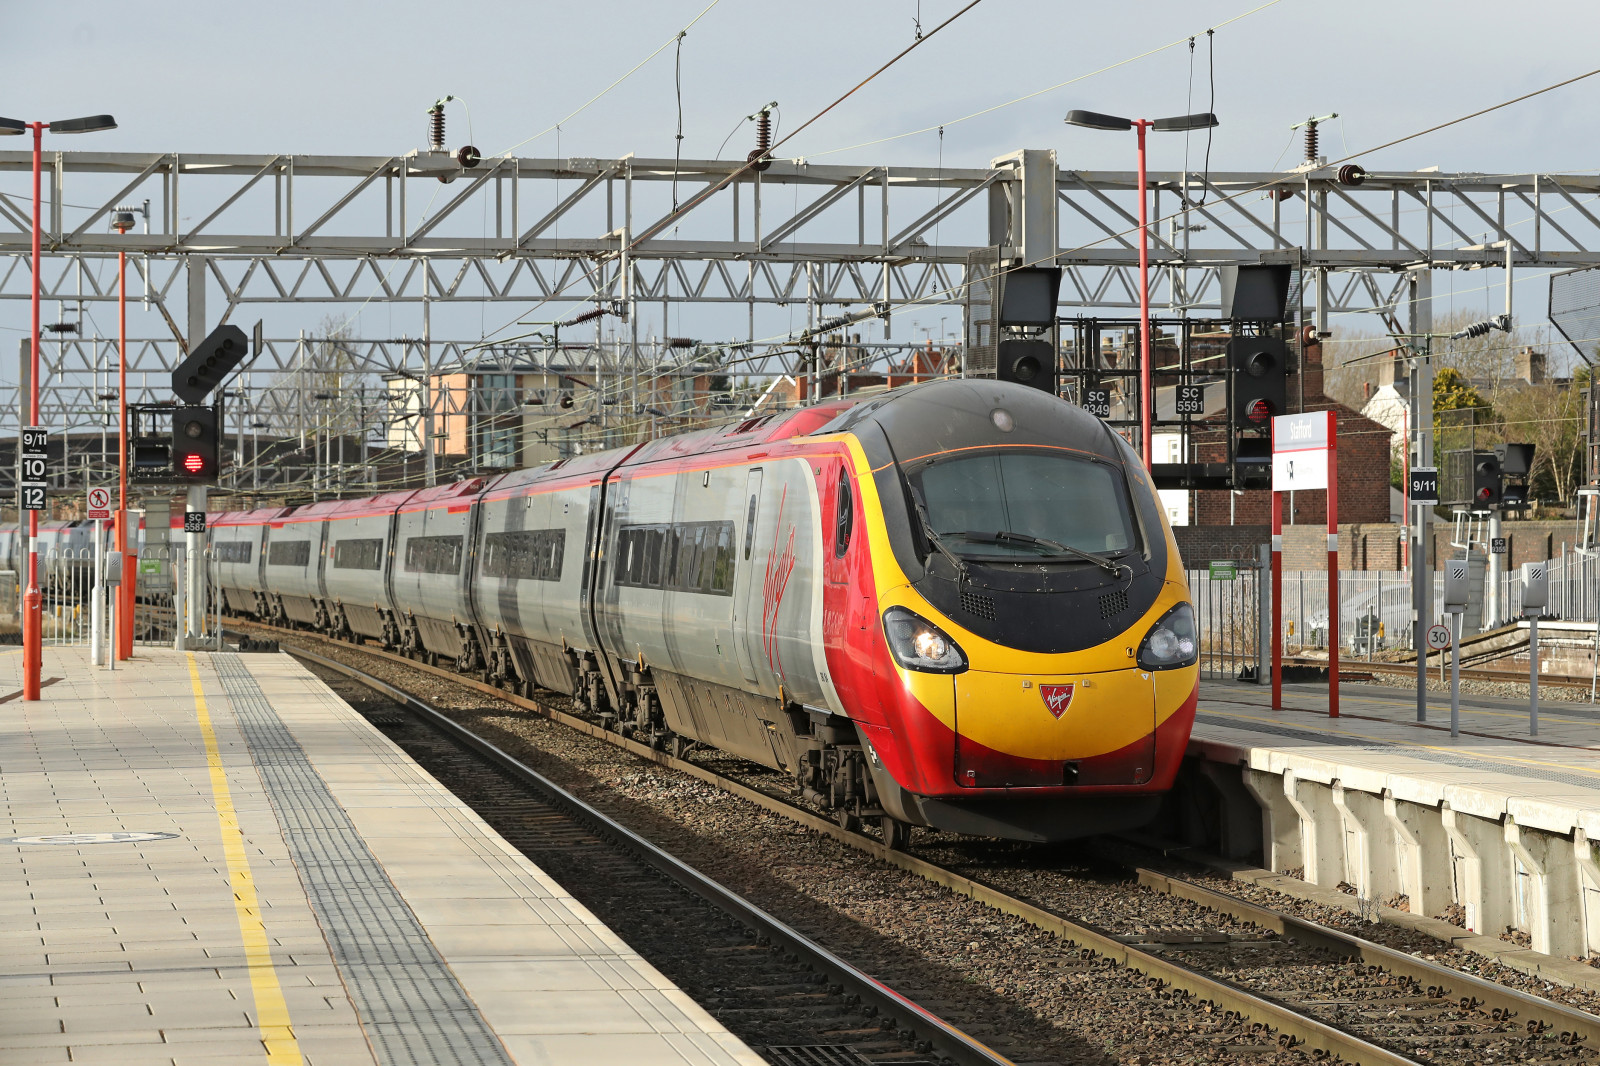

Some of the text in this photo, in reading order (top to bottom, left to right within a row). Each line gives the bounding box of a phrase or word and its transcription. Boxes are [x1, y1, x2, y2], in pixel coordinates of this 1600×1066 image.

[1088, 391, 1105, 401] SC
[1181, 388, 1199, 398] SC
[1082, 403, 1110, 416] 9349
[1177, 401, 1203, 412] 5591
[1290, 419, 1312, 440] Stafford
[24, 433, 47, 447] 9/11
[24, 460, 45, 476] 10
[1413, 480, 1436, 491] 9/11
[24, 488, 44, 505] 12
[189, 513, 202, 521] SC
[184, 523, 205, 532] 5587
[1431, 631, 1447, 643] 30
[1047, 687, 1070, 709] Virgin
